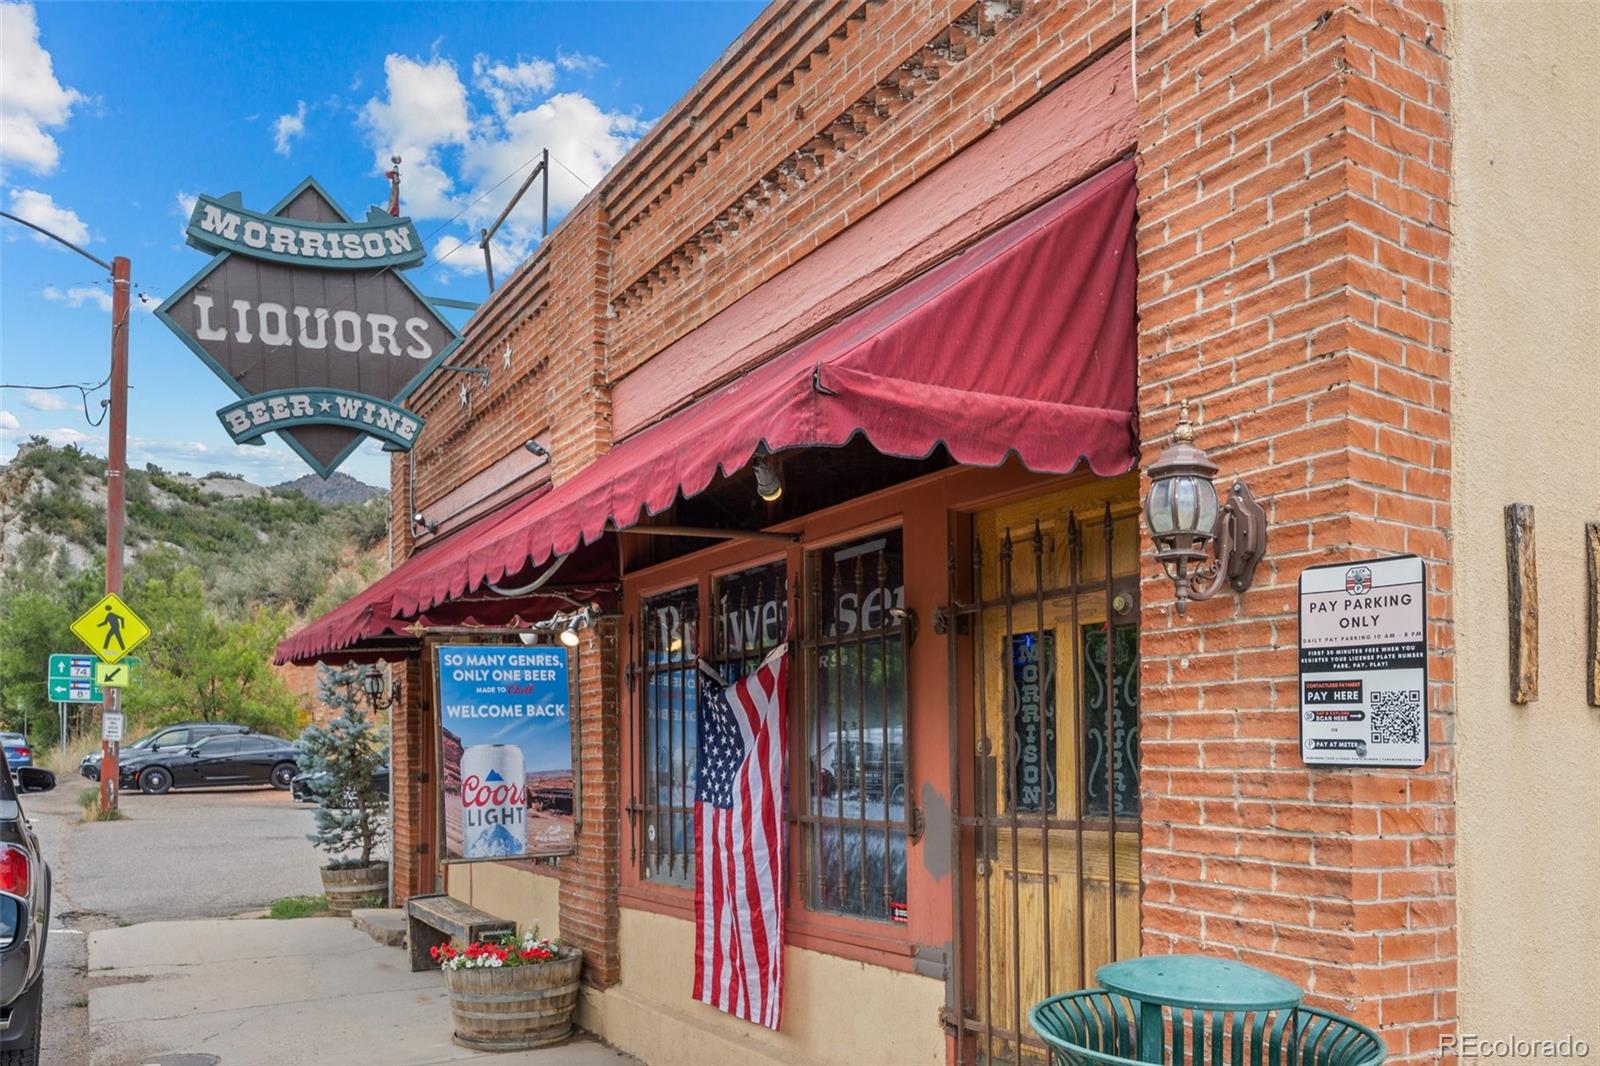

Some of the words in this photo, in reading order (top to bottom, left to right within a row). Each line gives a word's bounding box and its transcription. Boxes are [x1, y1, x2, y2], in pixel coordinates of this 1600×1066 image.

[201, 204, 413, 259] MORRISON
[193, 295, 433, 359] LIQUORS
[225, 394, 315, 434] BEER
[336, 396, 418, 441] WINE
[1310, 601, 1338, 613] PAY
[1345, 594, 1412, 610] PARKING
[1339, 615, 1380, 628] ONLY
[444, 655, 463, 666] SO
[466, 655, 505, 666] MANY
[508, 655, 563, 669] GENRES,
[453, 670, 489, 681] ONLY
[492, 670, 521, 681] ONE
[524, 670, 556, 681] BEER
[1308, 691, 1327, 701] PAY
[1334, 691, 1359, 700] HERE
[447, 704, 522, 718] WELCOME
[526, 704, 565, 717] BACK
[1019, 646, 1042, 804] MORRISON
[462, 775, 527, 808] Coors
[468, 807, 523, 826] LIGHT
